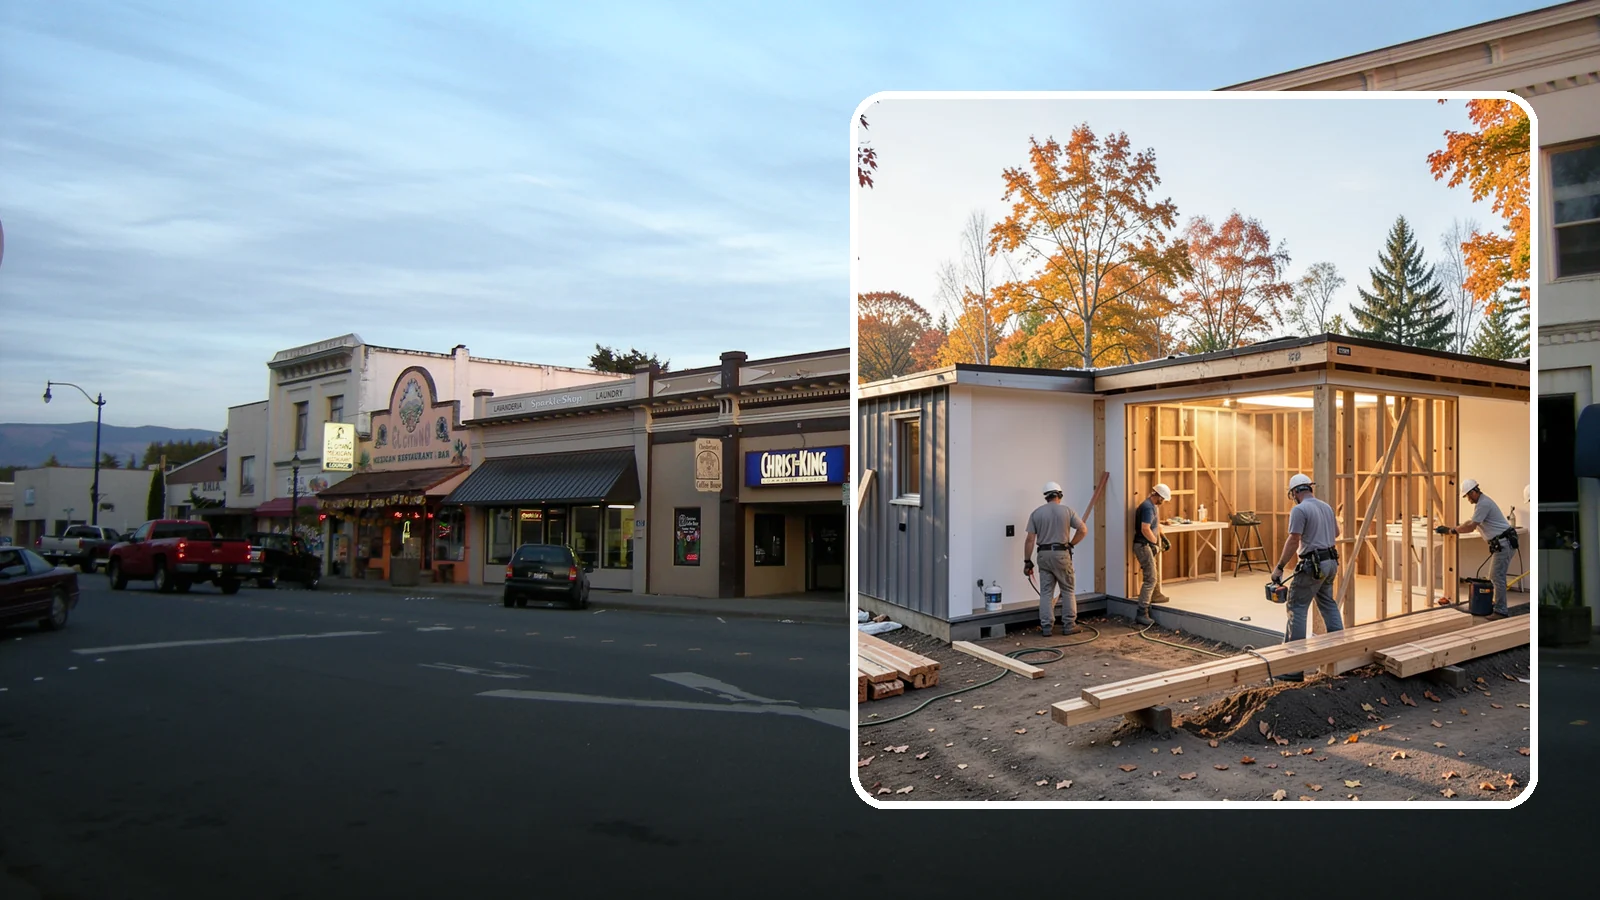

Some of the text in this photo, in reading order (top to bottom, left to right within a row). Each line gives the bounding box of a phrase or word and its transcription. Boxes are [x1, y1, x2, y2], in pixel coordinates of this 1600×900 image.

[494, 402, 522, 412] LAVANDERIA
[561, 394, 582, 405] Shop
[596, 389, 624, 400] LAUNDRY
[374, 455, 396, 464] MEXICAN
[397, 451, 433, 462] RESTAURANT
[438, 450, 450, 459] BAR
[760, 452, 797, 478] CHRIST
[799, 449, 828, 477] KING
